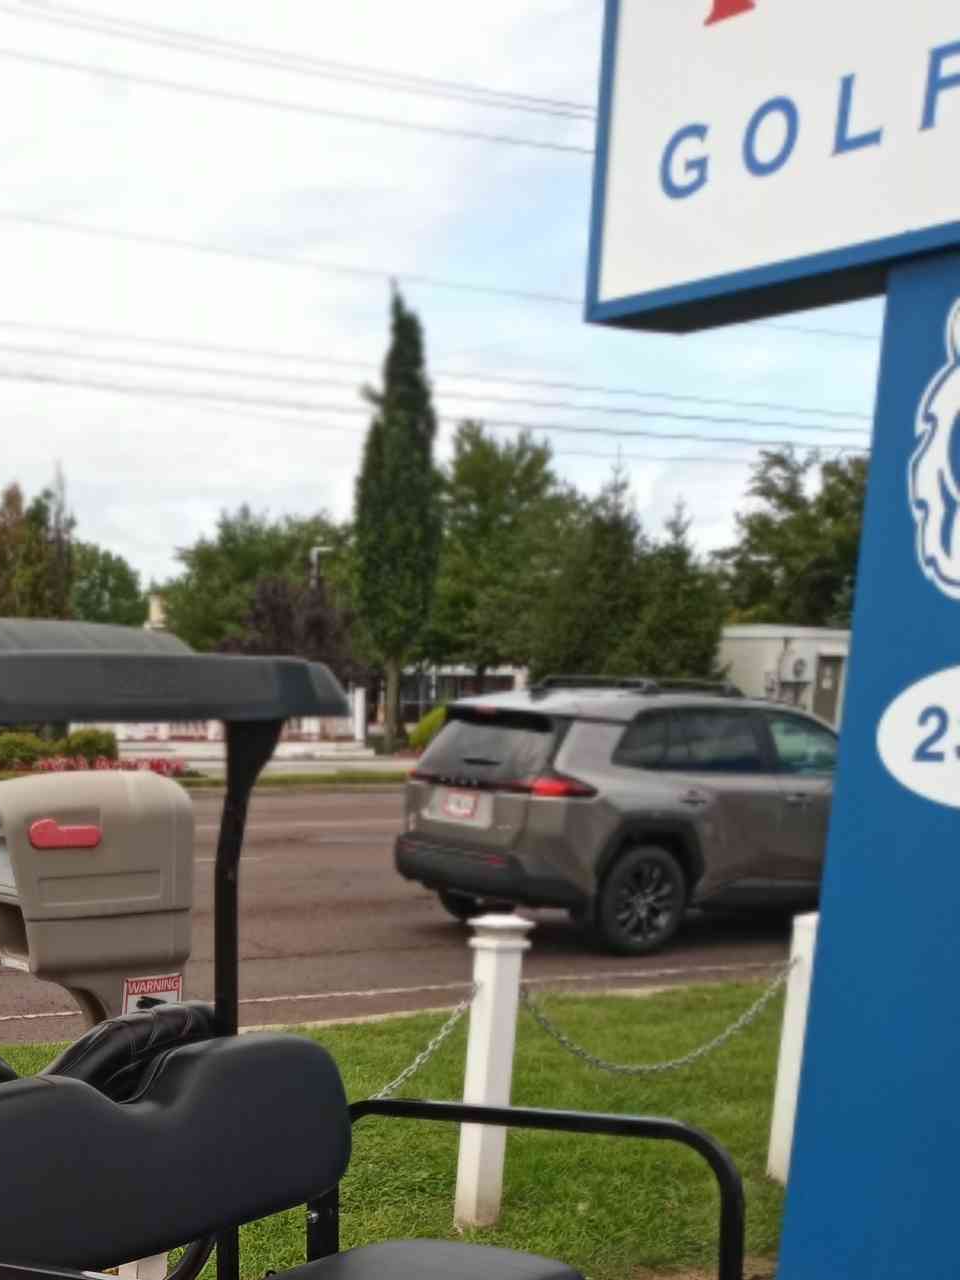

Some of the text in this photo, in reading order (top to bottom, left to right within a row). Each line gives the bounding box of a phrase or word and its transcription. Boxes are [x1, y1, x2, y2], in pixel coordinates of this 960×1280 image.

[659, 40, 960, 200] GOLF
[911, 704, 960, 763] 2
[127, 977, 179, 994] WARNING
